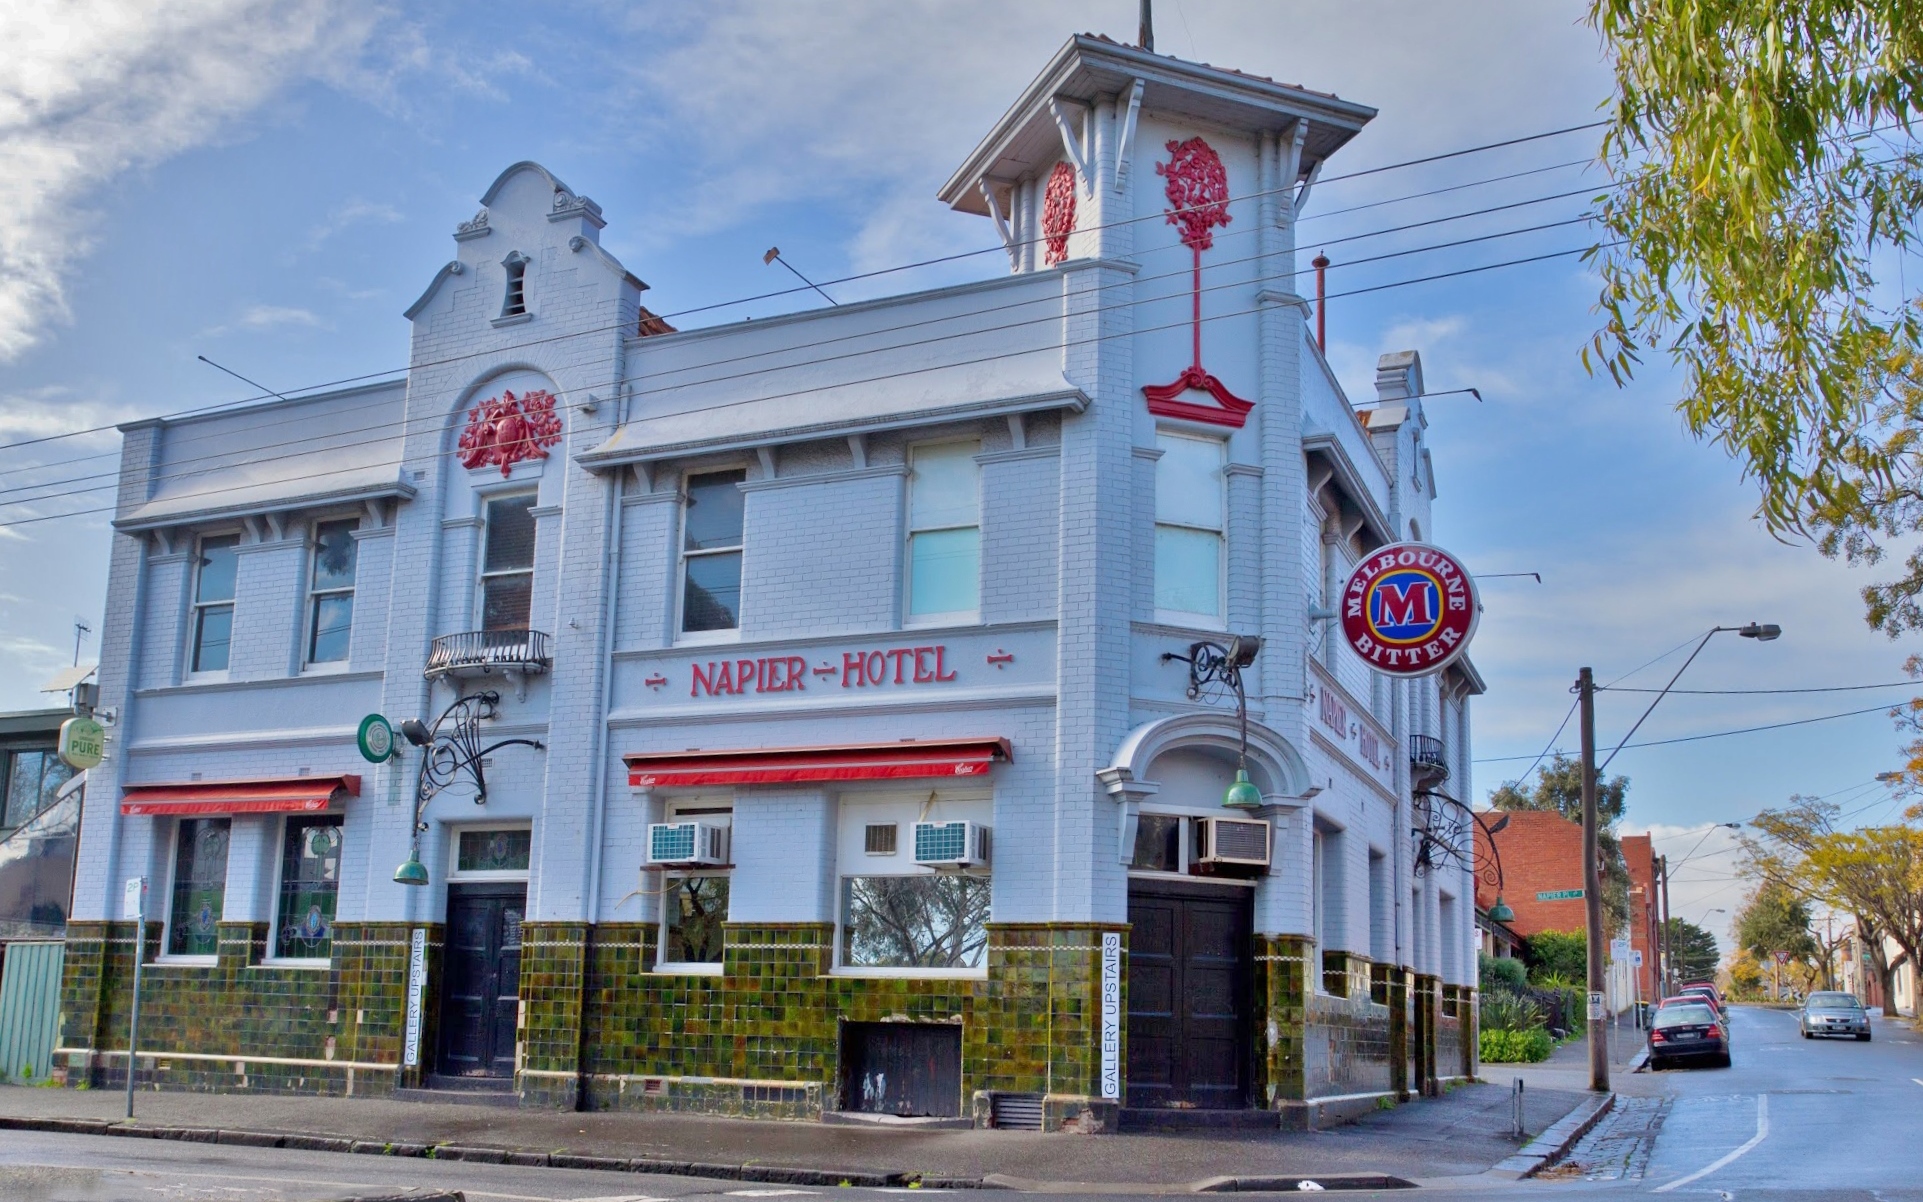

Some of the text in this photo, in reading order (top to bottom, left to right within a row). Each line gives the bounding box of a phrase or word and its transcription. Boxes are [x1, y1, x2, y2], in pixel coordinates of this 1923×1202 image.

[1347, 551, 1466, 618] MELBOURNE
[1374, 581, 1436, 628] M
[691, 646, 958, 697] NAPIER HOTEL
[1354, 627, 1462, 665] BITTER
[71, 740, 100, 756] PURE
[406, 931, 424, 1063] GALLERY UPSTAIRS
[1104, 936, 1117, 1095] GALLERY UPSTAIRS
